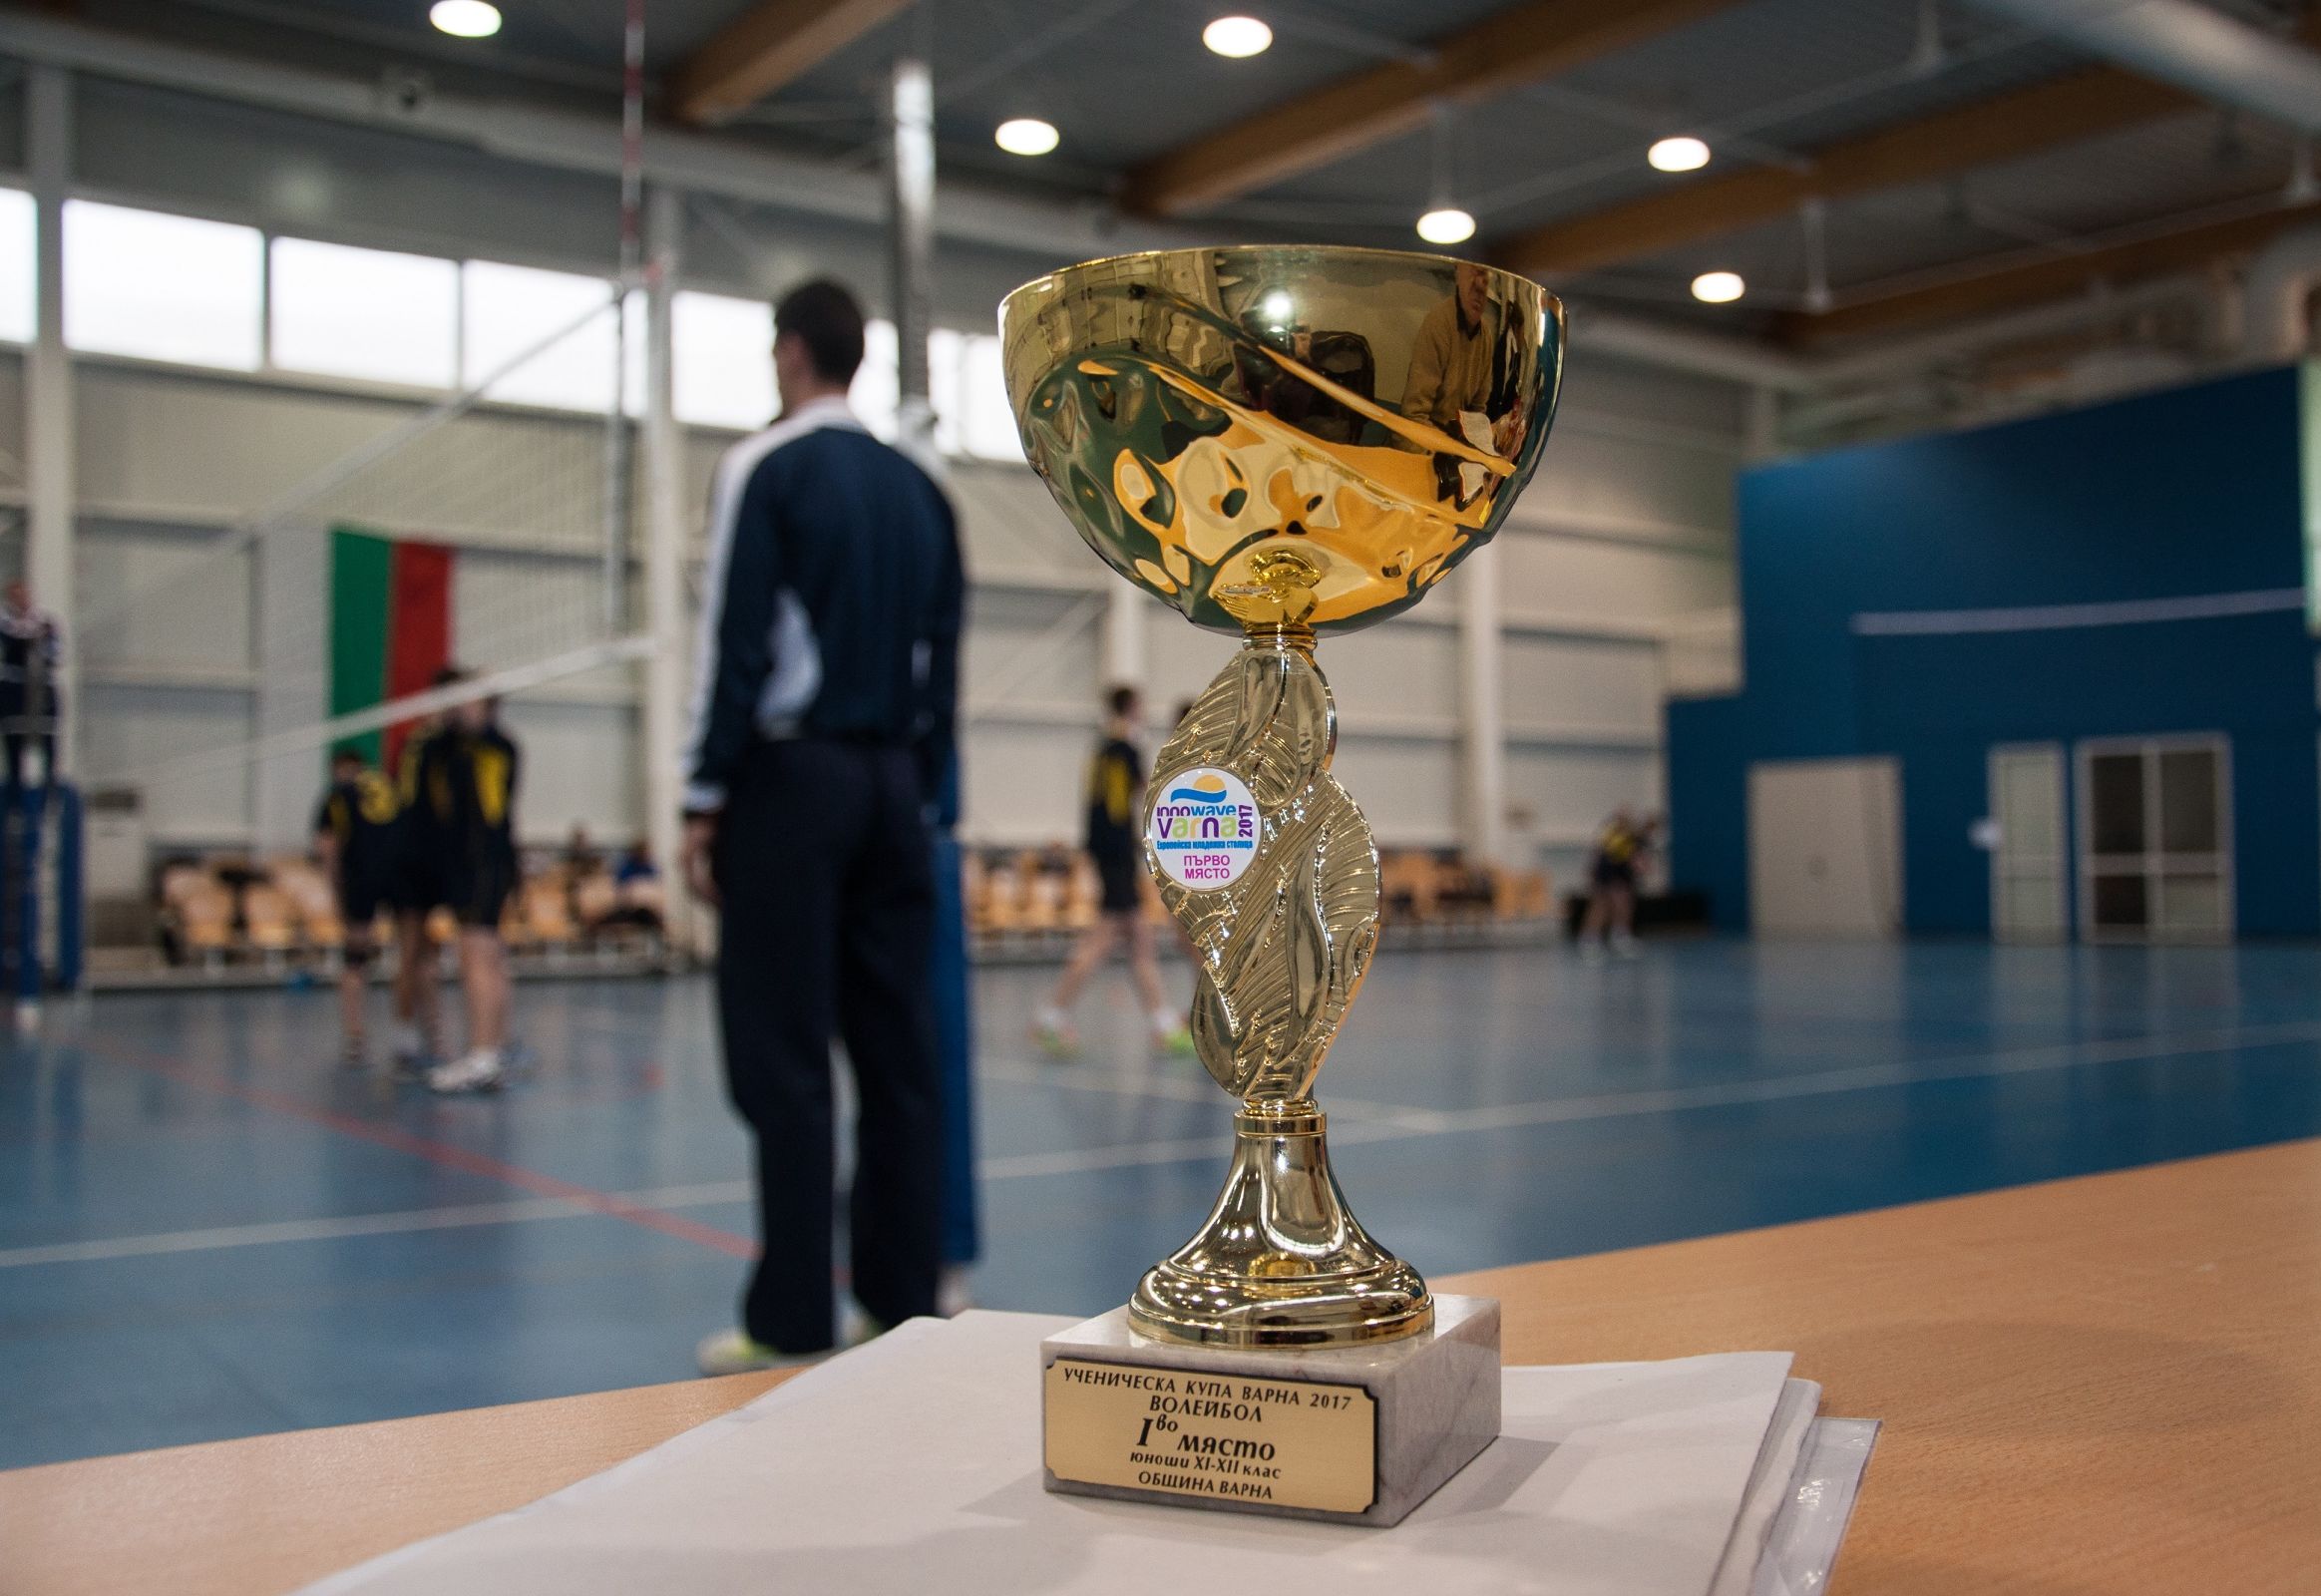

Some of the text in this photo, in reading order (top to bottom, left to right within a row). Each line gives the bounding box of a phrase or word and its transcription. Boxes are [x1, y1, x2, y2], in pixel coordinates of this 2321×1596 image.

[1238, 804, 1253, 838] 2017
[1183, 855, 1231, 867] ПЪРВО
[1184, 868, 1231, 880] МЯСТО
[1063, 1368, 1353, 1410] УЧЕНИЧЕСКА КУПА ВАРНА 2017
[1149, 1396, 1262, 1423] ВОЛЕЙБОЛ
[1176, 1433, 1276, 1461] място
[1129, 1451, 1190, 1469] юноши
[1243, 1463, 1282, 1480] клас
[1138, 1471, 1273, 1500] ОБЩИНА ВАРНА
